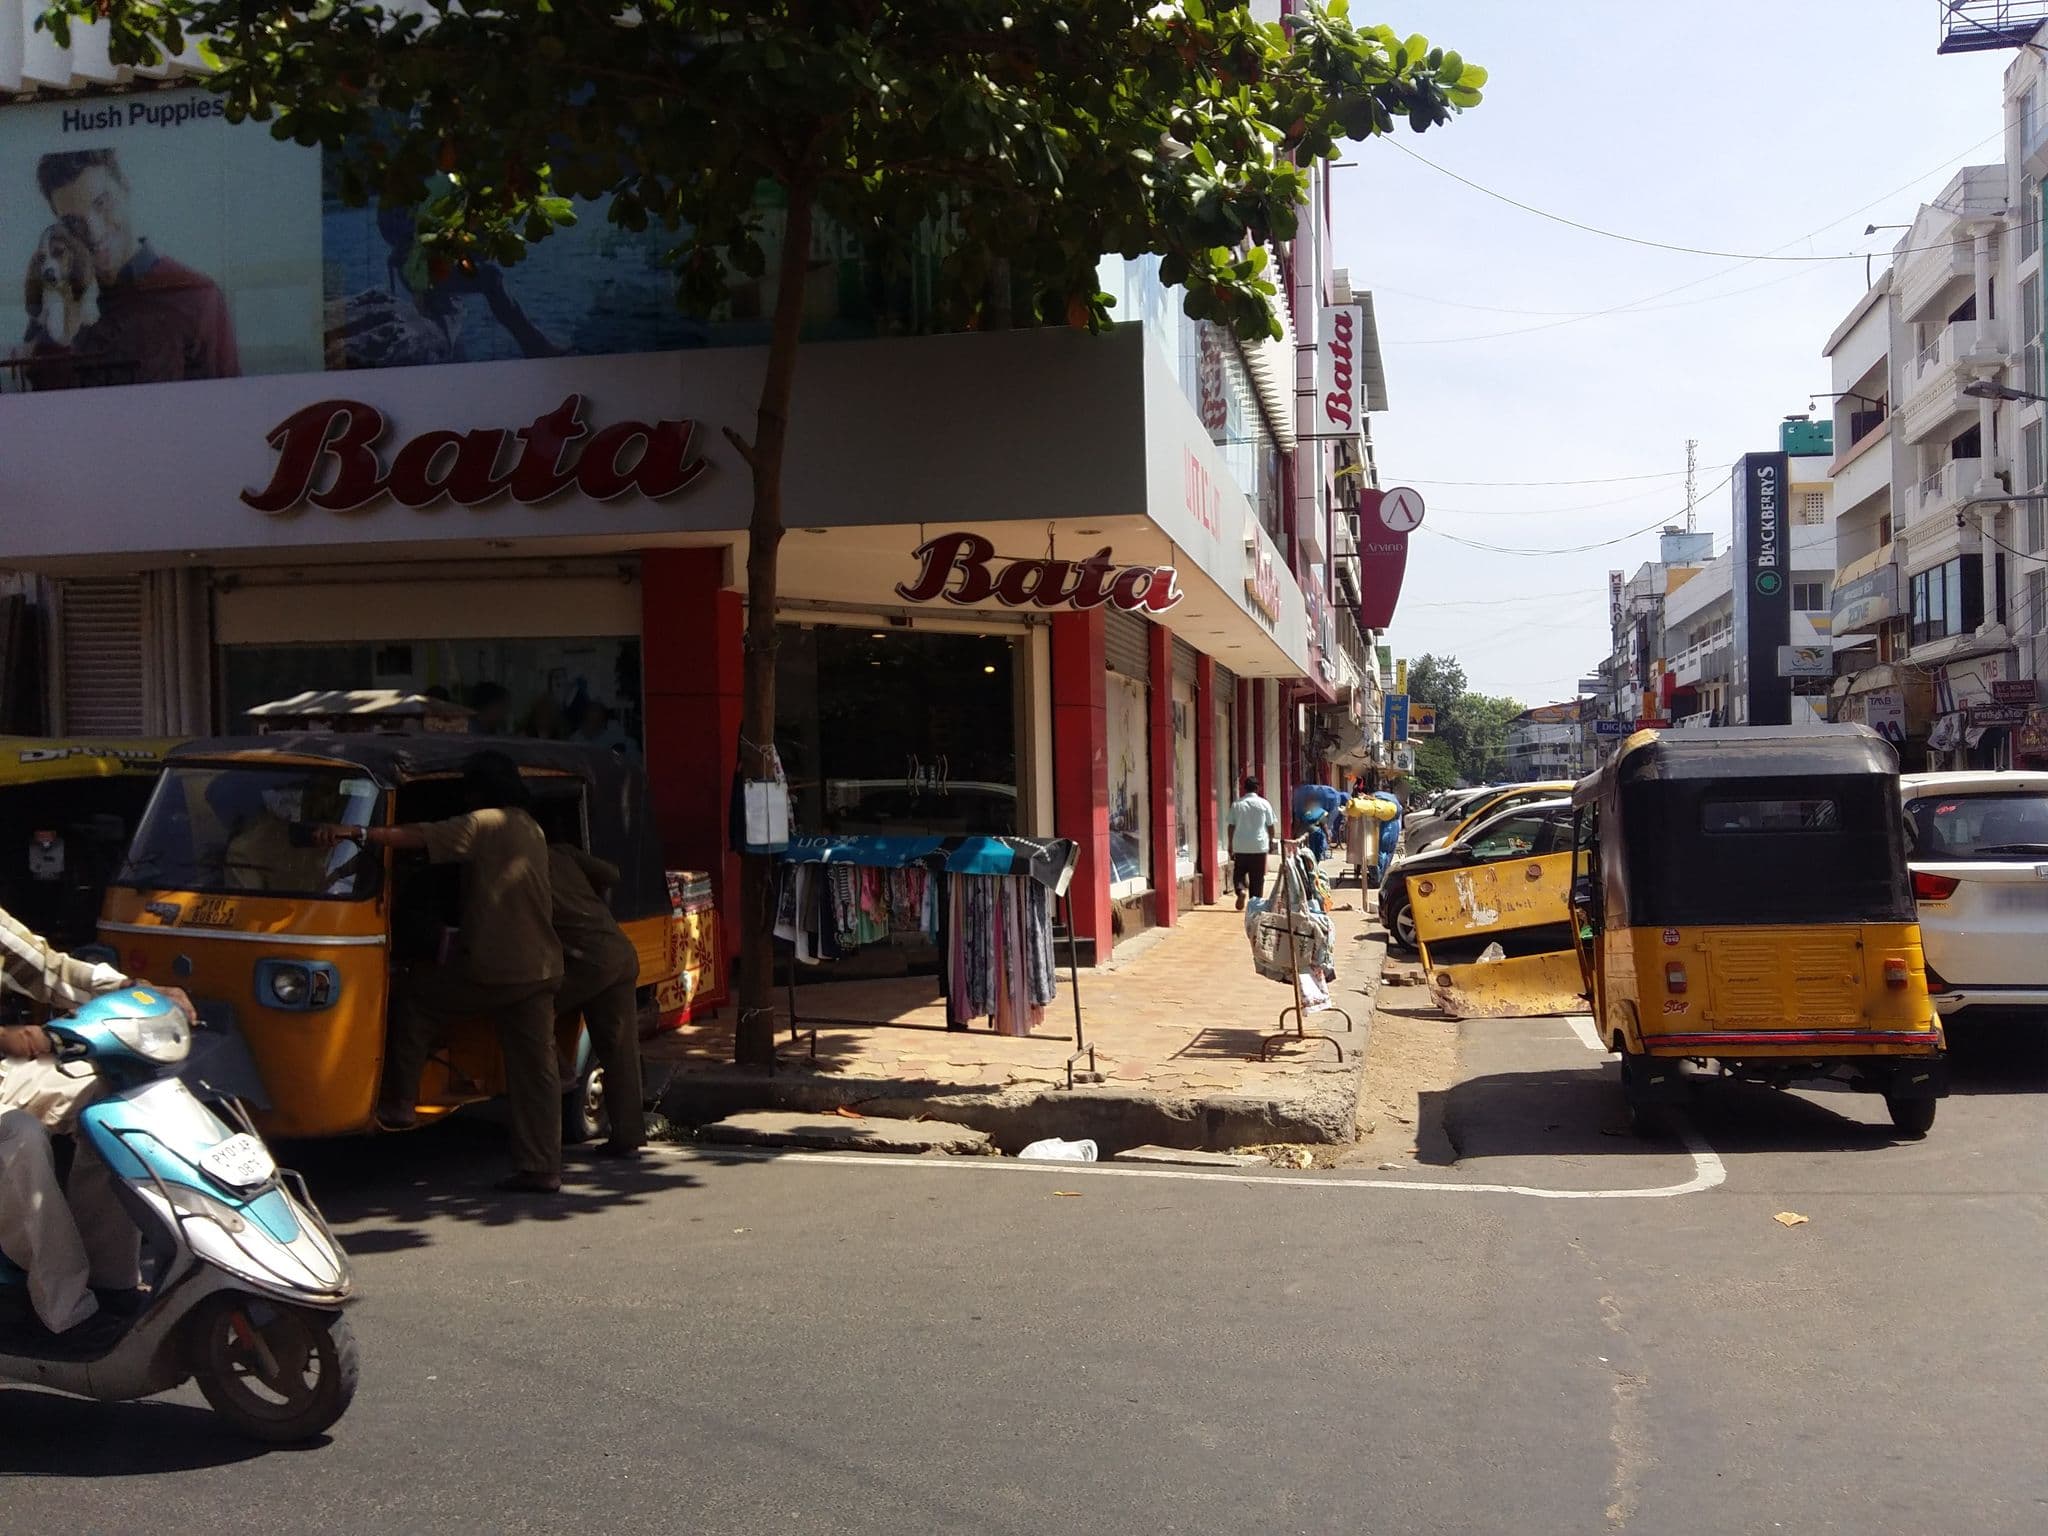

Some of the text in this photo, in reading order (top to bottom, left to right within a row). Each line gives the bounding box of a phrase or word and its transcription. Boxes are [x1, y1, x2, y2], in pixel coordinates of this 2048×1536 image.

[62, 97, 225, 133] Hush Puppies
[1325, 310, 1353, 431] Bata
[239, 392, 708, 514] Bata
[1757, 465, 1776, 567] BLACKBERRYS
[895, 532, 1184, 613] Bata
[1611, 573, 1623, 623] METRO
[1663, 1000, 1691, 1015] Stop
